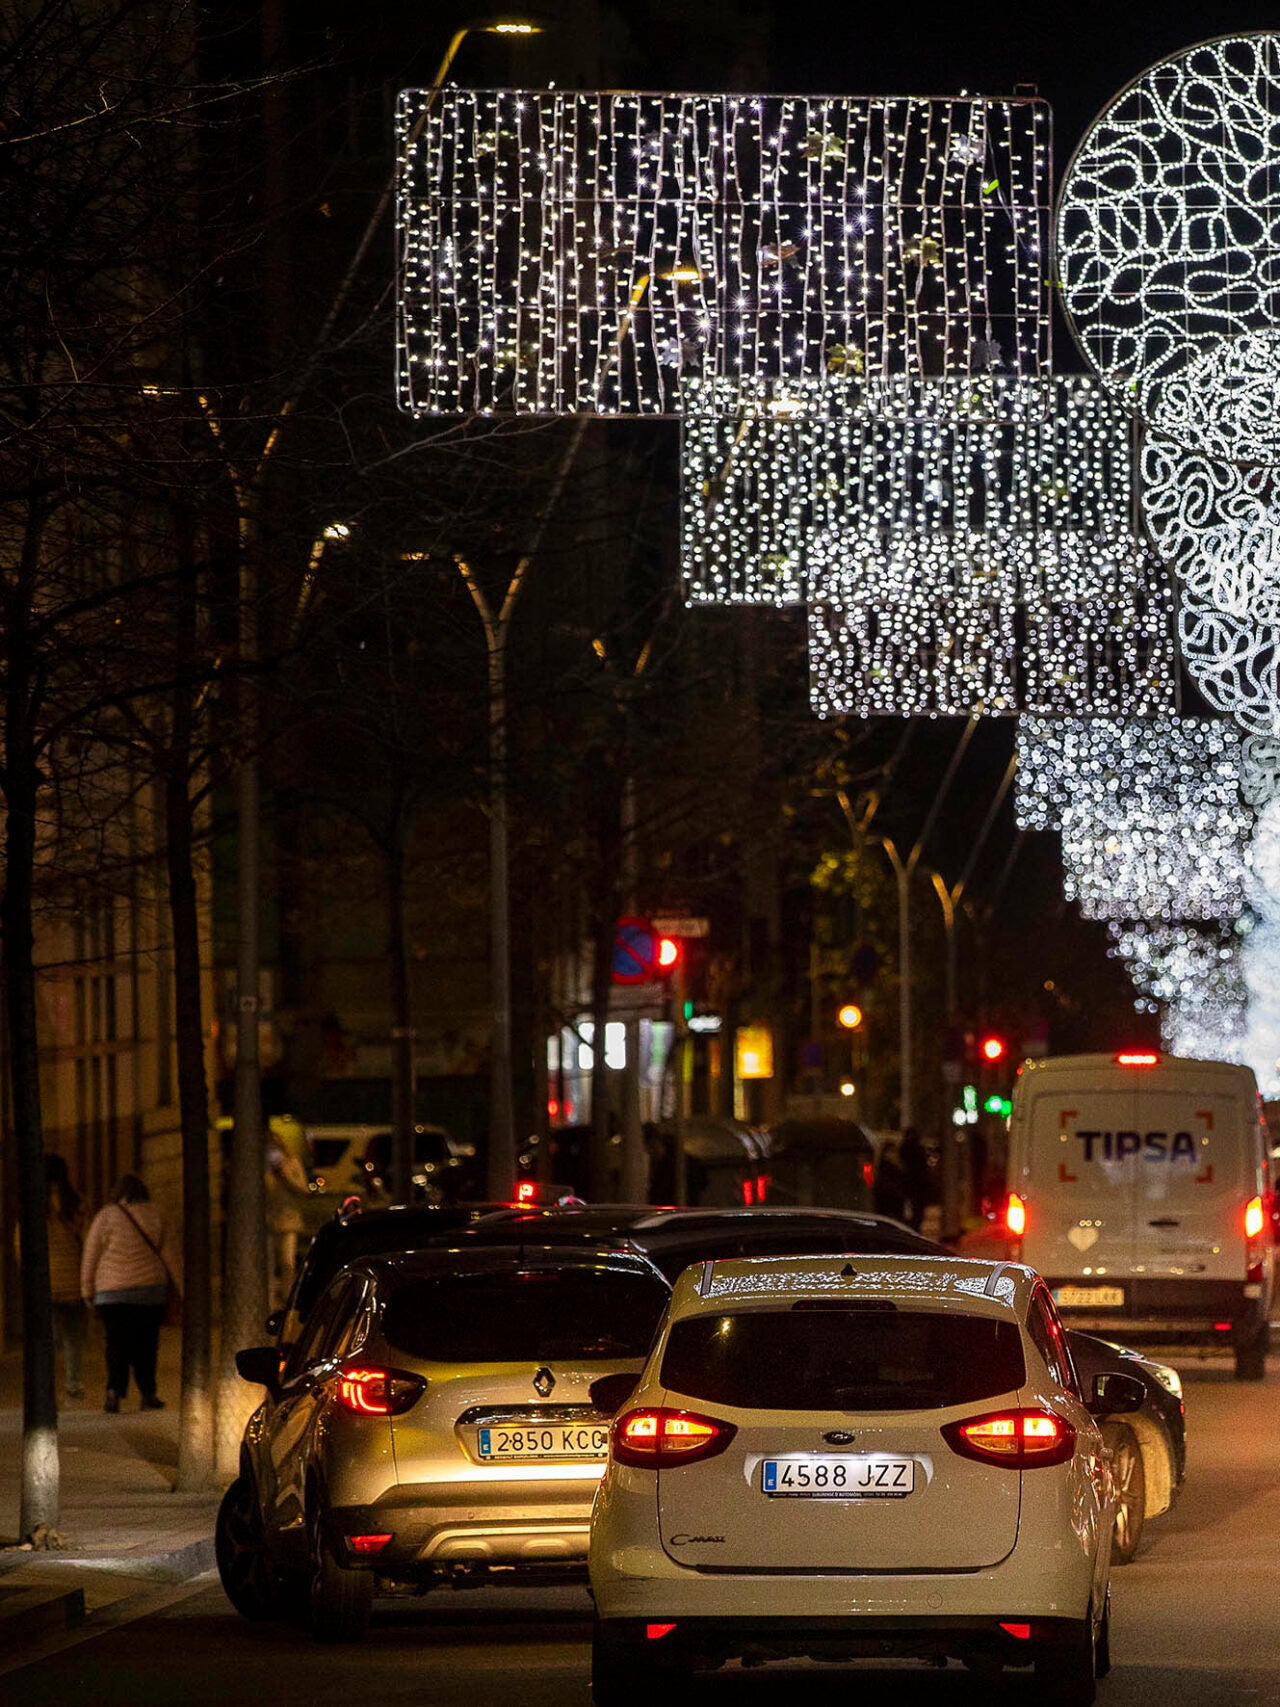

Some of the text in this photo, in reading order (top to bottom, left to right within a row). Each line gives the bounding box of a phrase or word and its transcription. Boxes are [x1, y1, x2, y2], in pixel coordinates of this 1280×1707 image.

[1076, 1131, 1197, 1163] TIPSA
[497, 1431, 553, 1452] 2850
[781, 1465, 847, 1487] 4588
[858, 1464, 907, 1487] JZZ
